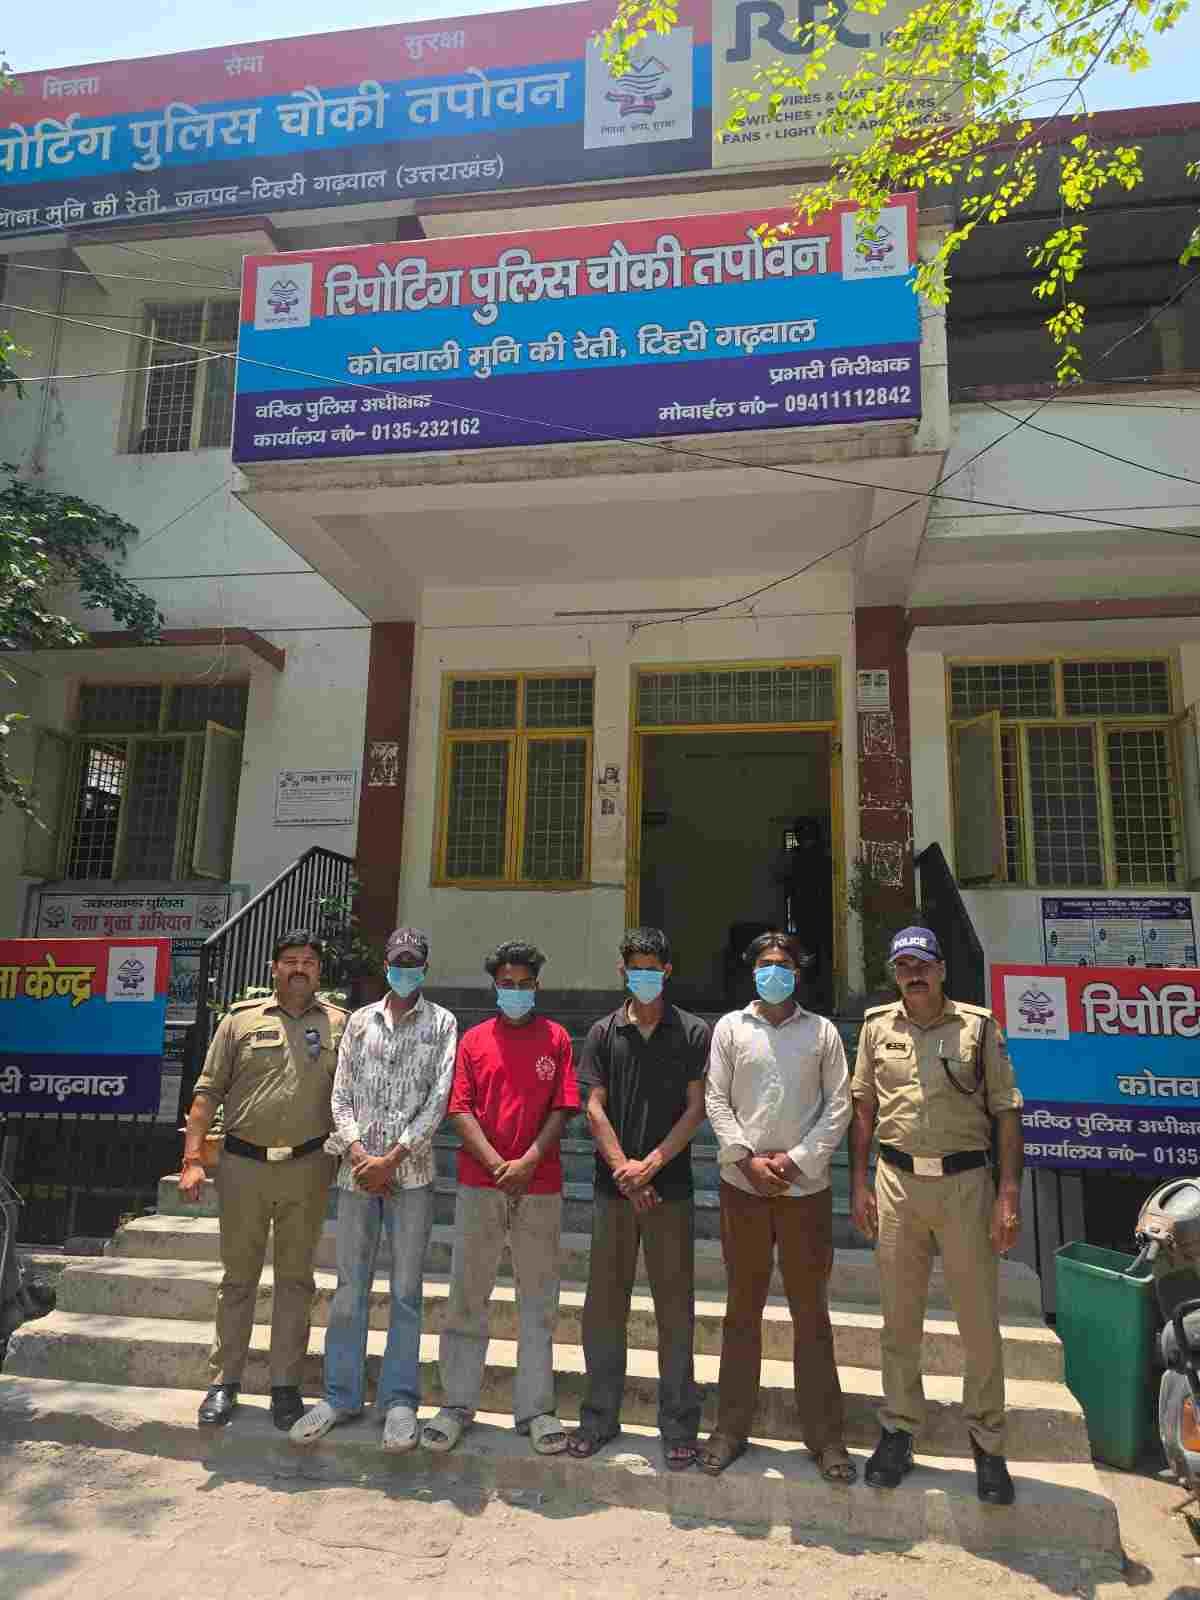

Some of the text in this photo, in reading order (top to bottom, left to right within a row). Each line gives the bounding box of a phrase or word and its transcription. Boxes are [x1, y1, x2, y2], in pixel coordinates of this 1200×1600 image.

[404, 30, 465, 60] सुरक्षा
[224, 52, 265, 76] सेवा
[129, 102, 263, 172] पुलिस
[276, 80, 391, 137] चौकी
[404, 66, 572, 125] तपोवन
[722, 127, 762, 144] FANS
[45, 197, 86, 227] मुनि
[92, 192, 119, 217] की
[469, 247, 581, 326] पुलिस
[586, 233, 687, 293] चौकी
[690, 225, 831, 285] तपोवन
[347, 339, 462, 377] कोतवाली
[468, 335, 523, 379] मुनि
[528, 331, 568, 362] की
[637, 319, 710, 354] टिहरी
[769, 355, 912, 385] प्रभारी निरीक्षक
[256, 394, 433, 422] वरिष्ठ पुलिस अधीक्षक
[785, 386, 912, 413] 09411112842
[254, 427, 326, 447] कार्यालय
[372, 417, 481, 441] 0135-232162
[894, 935, 928, 950] POLICE
[1080, 981, 1200, 1037] रिपोटि
[1022, 1110, 1073, 1130] वरिष्ठ
[1076, 1112, 1134, 1137] पुलिस
